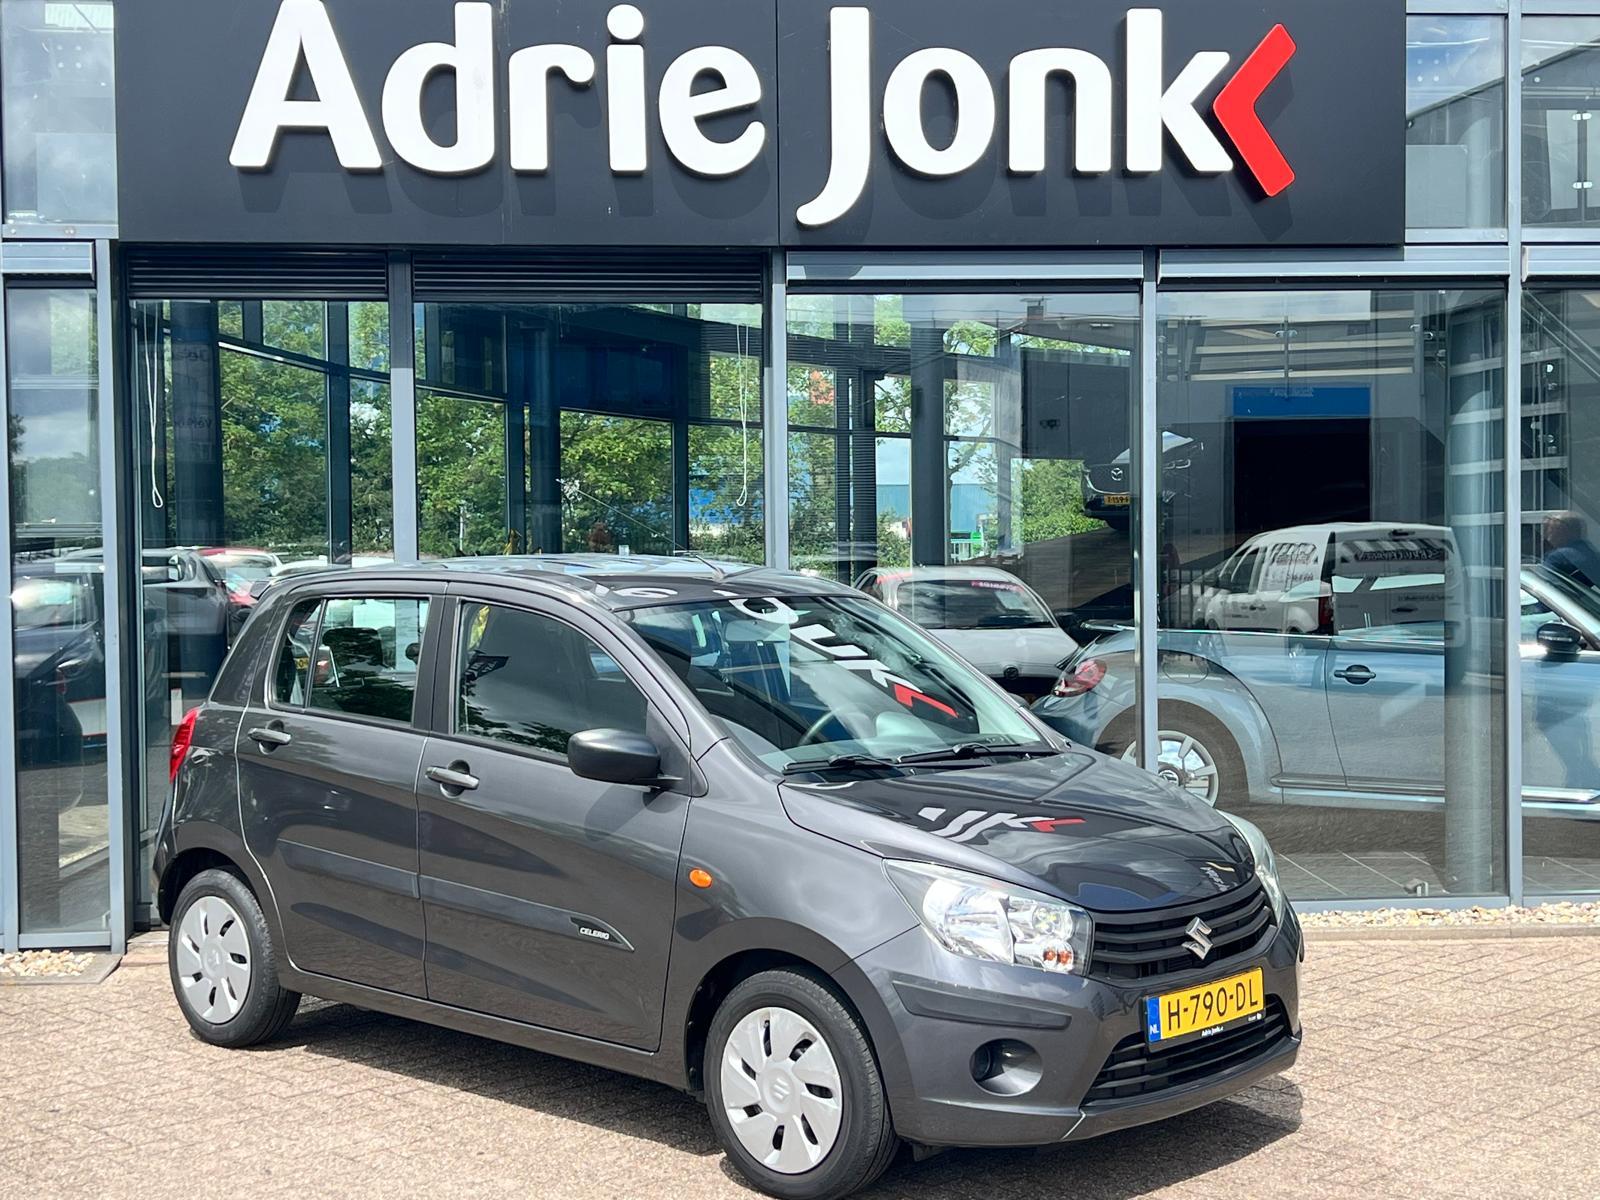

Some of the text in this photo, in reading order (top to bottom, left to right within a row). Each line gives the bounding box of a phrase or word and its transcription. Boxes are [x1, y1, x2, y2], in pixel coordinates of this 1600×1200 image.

[229, 0, 1234, 228] Adrie Jonk
[580, 927, 609, 940] CELERIO
[1168, 979, 1258, 1030] H-790-DL
[1149, 1024, 1159, 1036] NL
